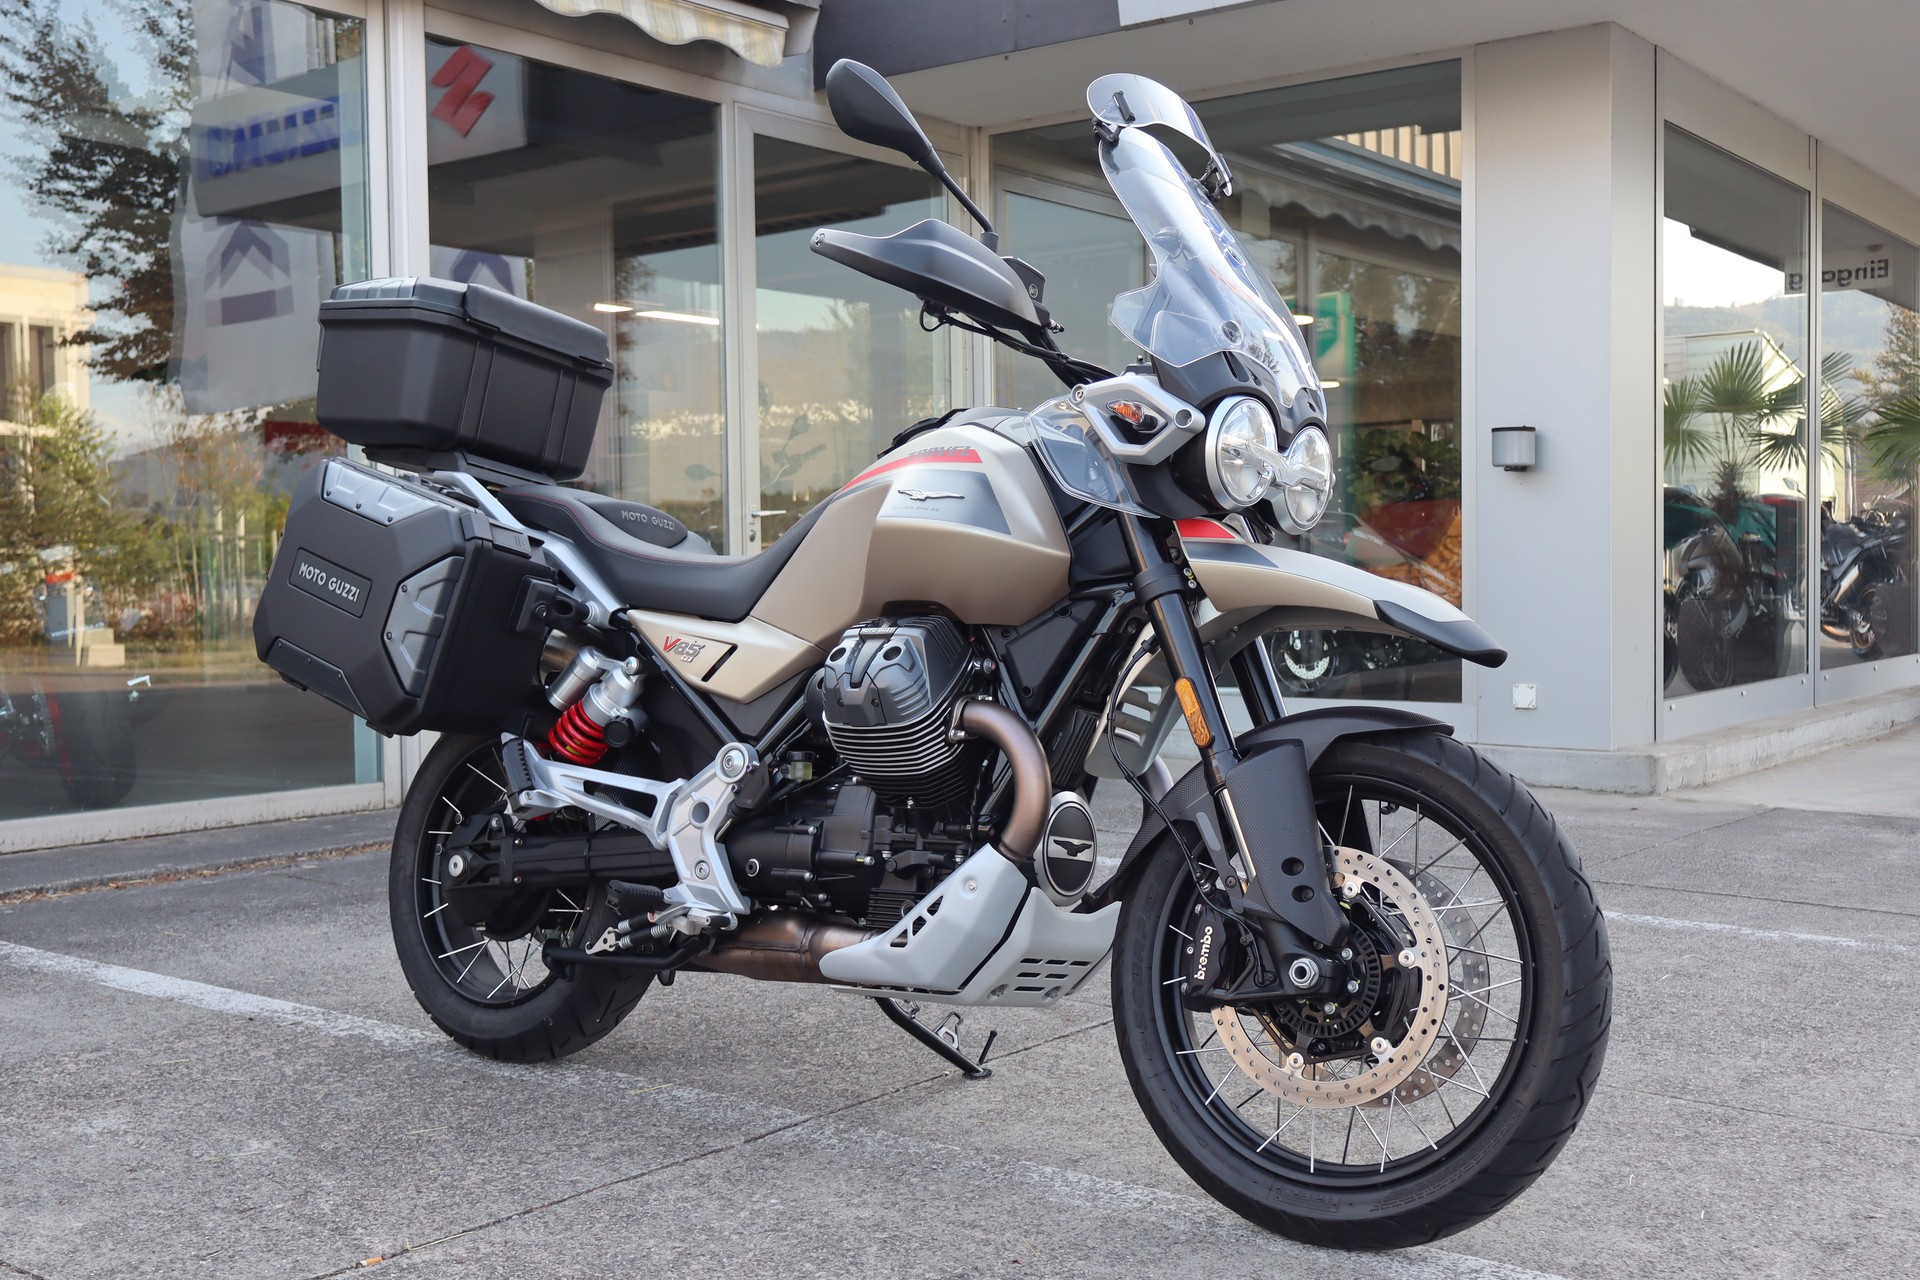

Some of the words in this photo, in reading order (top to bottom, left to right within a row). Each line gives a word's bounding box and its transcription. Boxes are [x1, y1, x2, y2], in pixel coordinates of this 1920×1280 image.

[621, 510, 648, 523] MOTO
[651, 516, 676, 531] GUZZI
[299, 562, 327, 586] MOTO
[328, 577, 360, 602] GUZZI
[663, 635, 702, 658] V85
[1194, 926, 1213, 980] brembo
